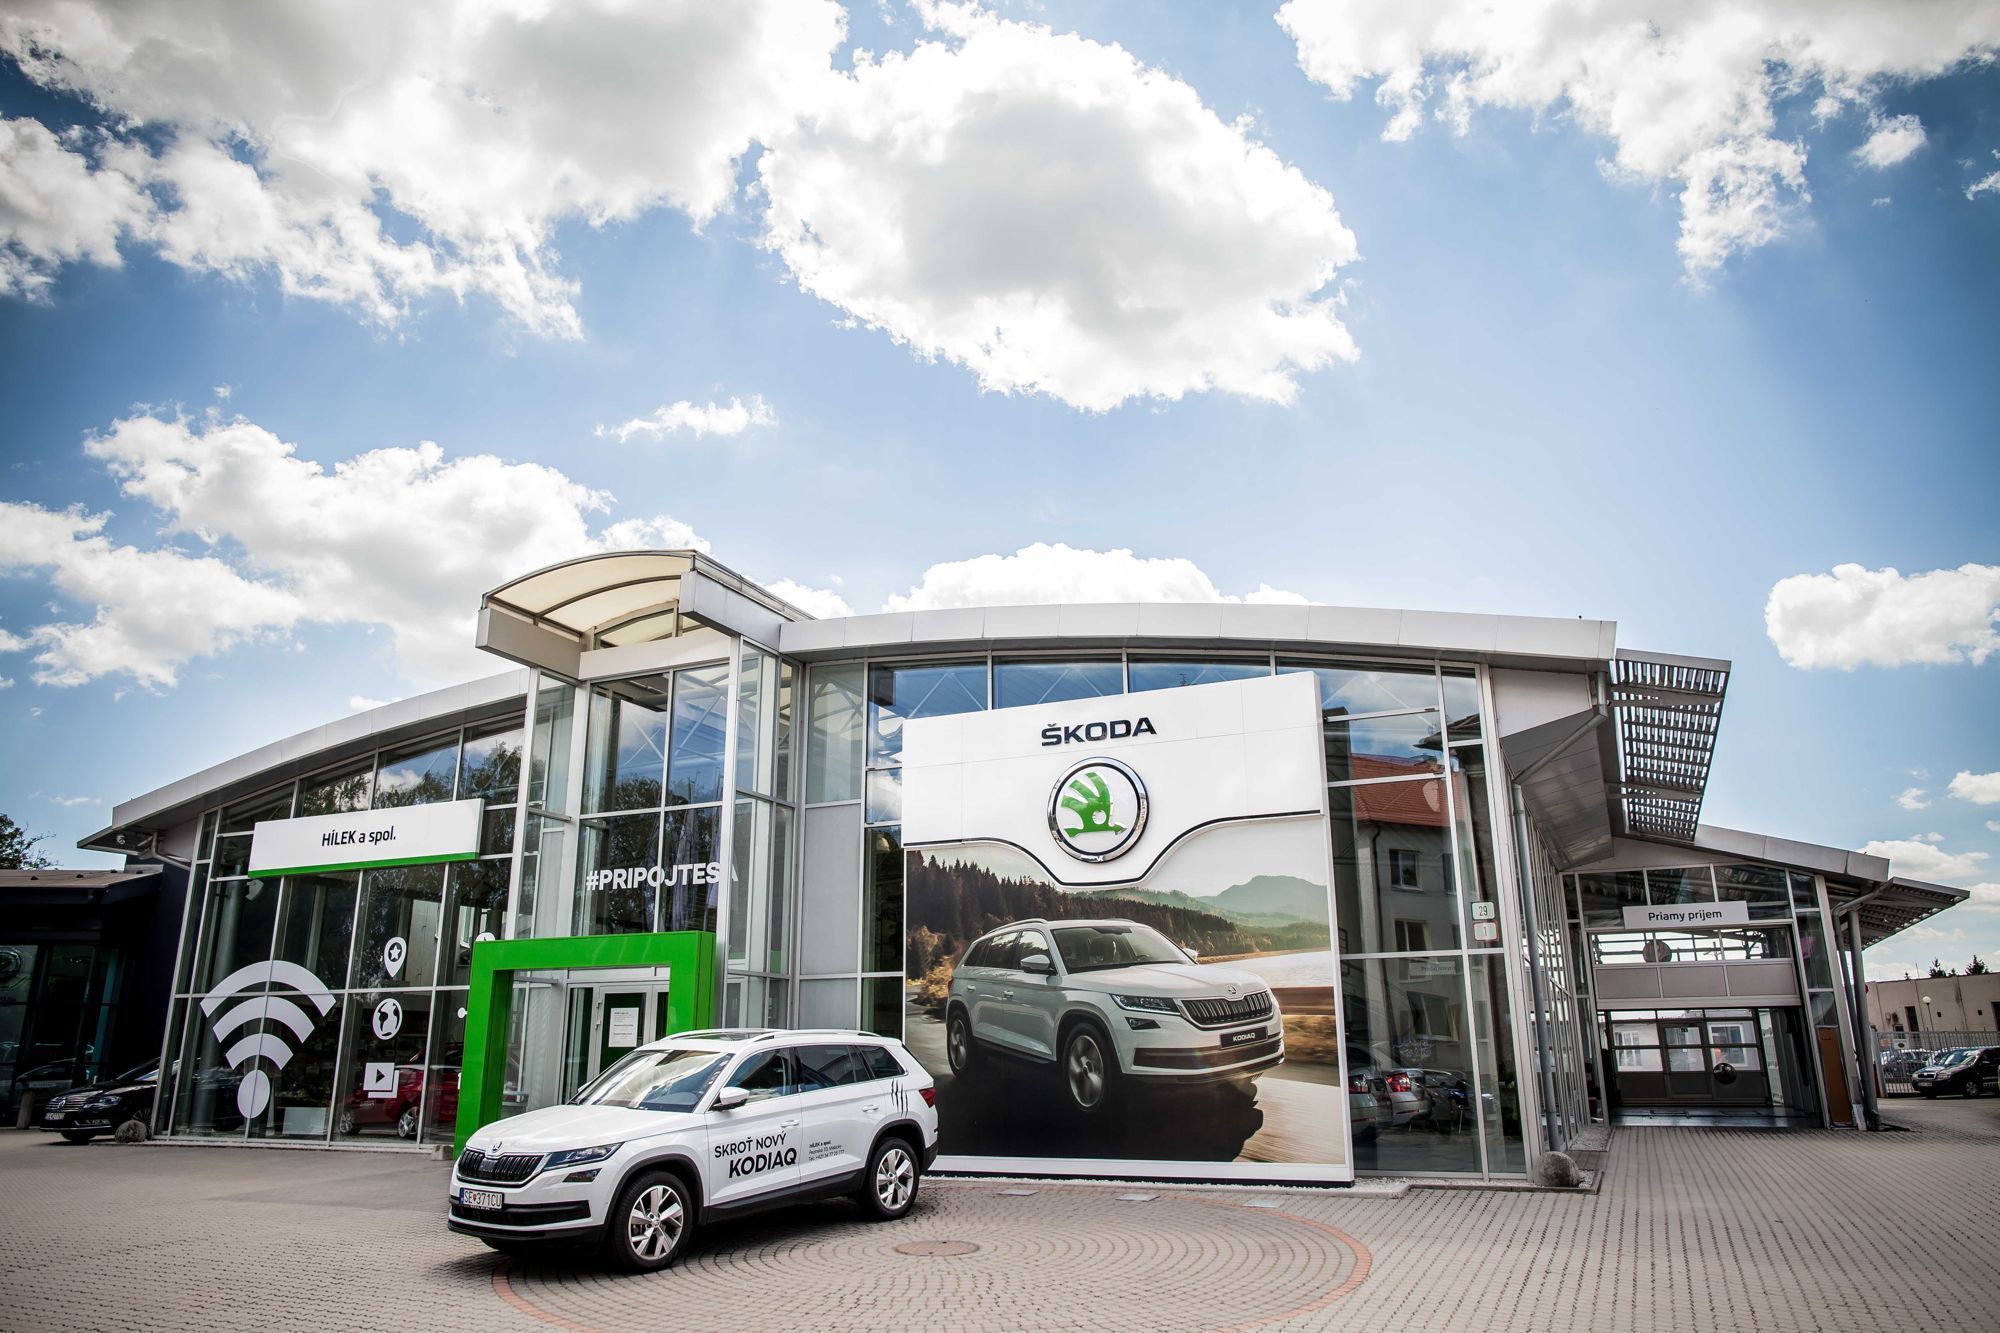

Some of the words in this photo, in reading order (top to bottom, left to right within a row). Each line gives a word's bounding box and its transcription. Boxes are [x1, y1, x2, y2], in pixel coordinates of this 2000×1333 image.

[1041, 716, 1157, 746] ŠKODA
[321, 829, 357, 847] HÍLEK
[358, 832, 366, 843] a
[368, 825, 396, 846] spol.
[1478, 905, 1488, 917] 29
[1648, 911, 1685, 922] Priamy
[1232, 1032, 1256, 1042] KODIAQ
[714, 1136, 753, 1158] SKROŤ
[756, 1130, 787, 1151] NOVÝ
[728, 1147, 797, 1179] KODIAQ
